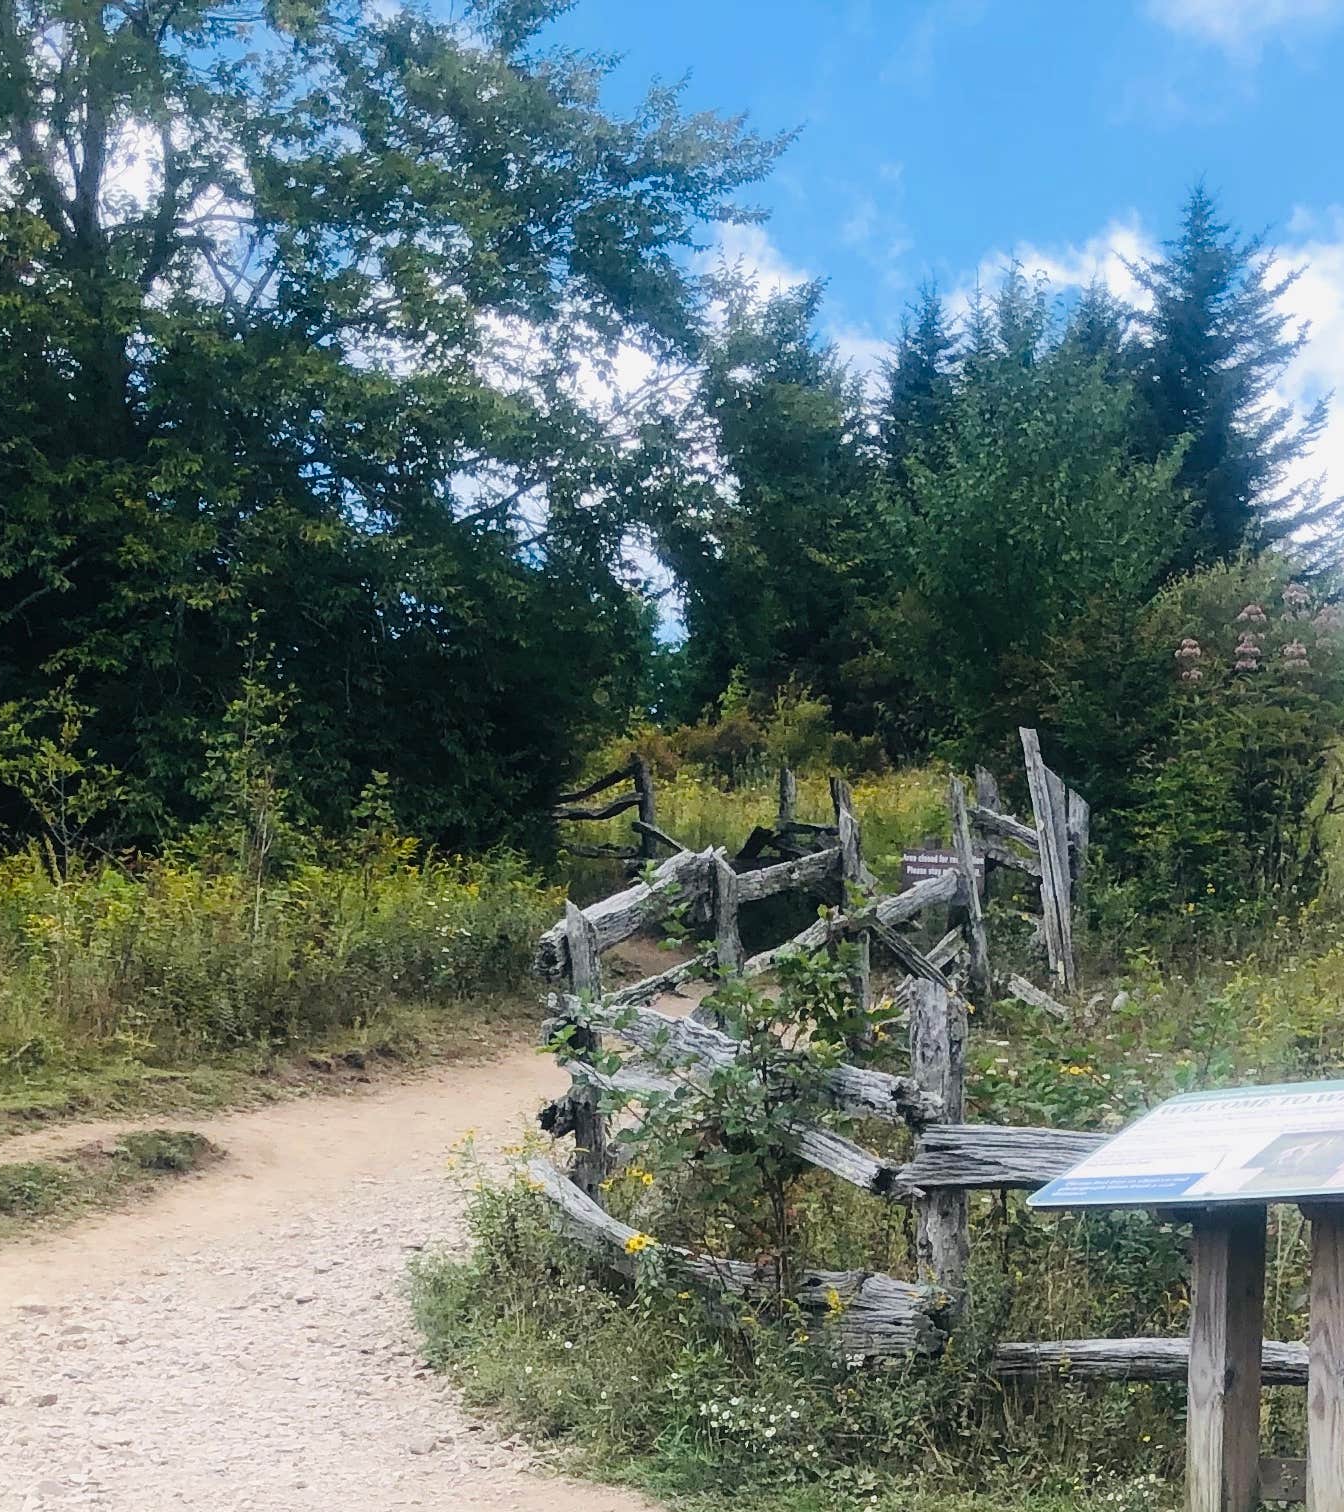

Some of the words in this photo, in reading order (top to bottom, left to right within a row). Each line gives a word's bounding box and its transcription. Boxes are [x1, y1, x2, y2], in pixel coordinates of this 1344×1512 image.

[918, 854, 938, 863] closed
[939, 854, 948, 863] for
[907, 866, 927, 874] Please
[1160, 1096, 1274, 1115] WELCOME
[1280, 1095, 1313, 1106] TO
